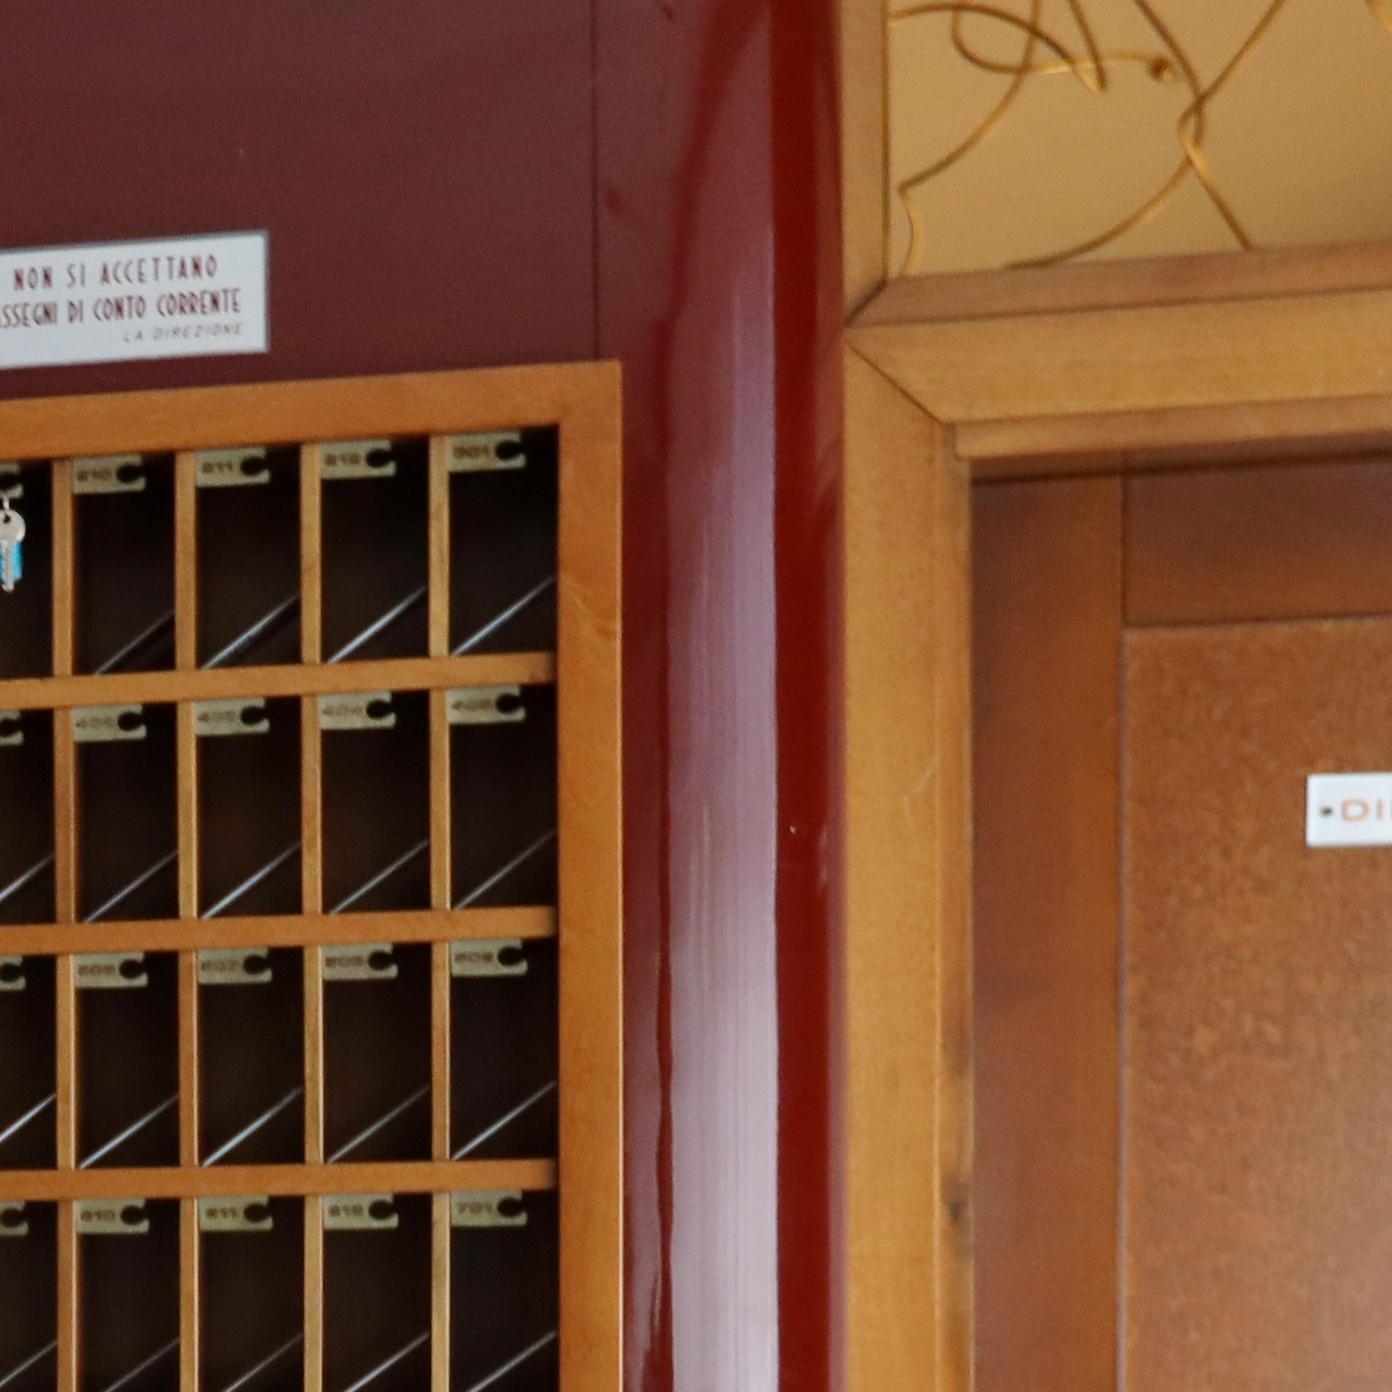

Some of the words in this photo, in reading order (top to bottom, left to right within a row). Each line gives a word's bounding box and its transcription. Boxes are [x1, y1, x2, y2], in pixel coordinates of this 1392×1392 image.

[13, 265, 54, 291] NON
[66, 263, 87, 288] SI
[99, 254, 218, 285] ACCETTANO
[67, 299, 85, 323] DI
[93, 295, 148, 322] CONTO
[156, 288, 243, 317] CORRENTE
[123, 330, 144, 343] LA
[153, 322, 245, 342] DIREZIONE
[1342, 799, 1392, 821] DI
